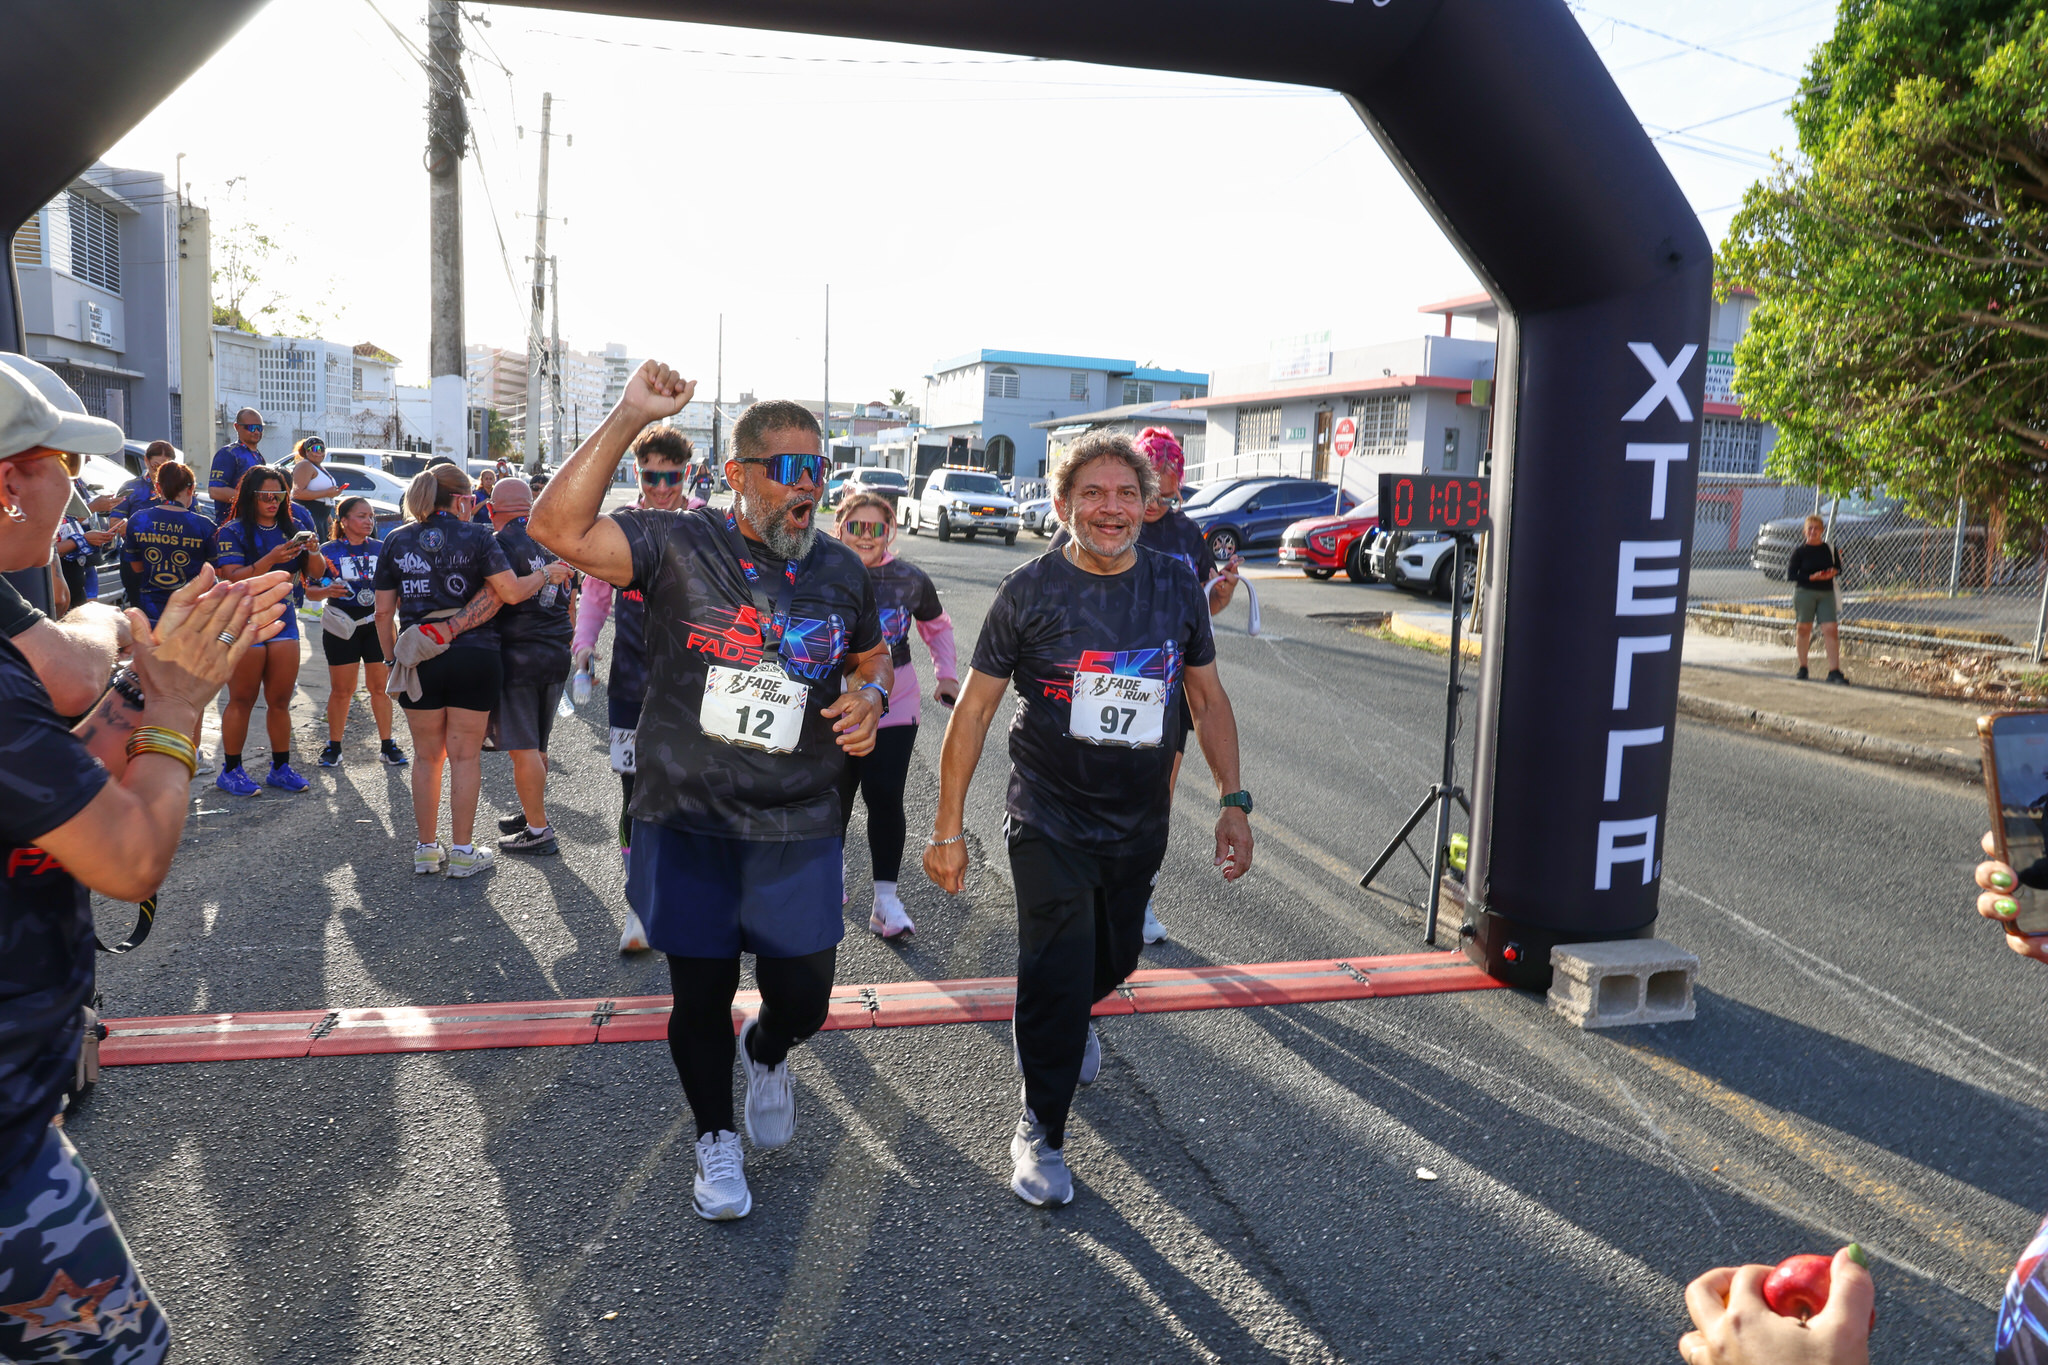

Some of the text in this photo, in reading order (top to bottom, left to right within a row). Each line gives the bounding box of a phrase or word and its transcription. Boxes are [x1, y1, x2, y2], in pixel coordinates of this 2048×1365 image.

[1341, 424, 1350, 432] NO
[211, 469, 224, 478] TF
[152, 521, 184, 534] TEAM
[134, 532, 203, 549] TAINOS FIT
[219, 541, 233, 551] TF
[402, 579, 431, 594] EME
[686, 632, 765, 667] FADE
[745, 675, 782, 692] FADE
[1107, 677, 1141, 691] FADE
[751, 689, 760, 698] &
[760, 691, 791, 705] RUN
[1115, 689, 1123, 698] &
[1123, 691, 1151, 702] RUN
[735, 705, 775, 740] 12
[1099, 705, 1137, 735] 97
